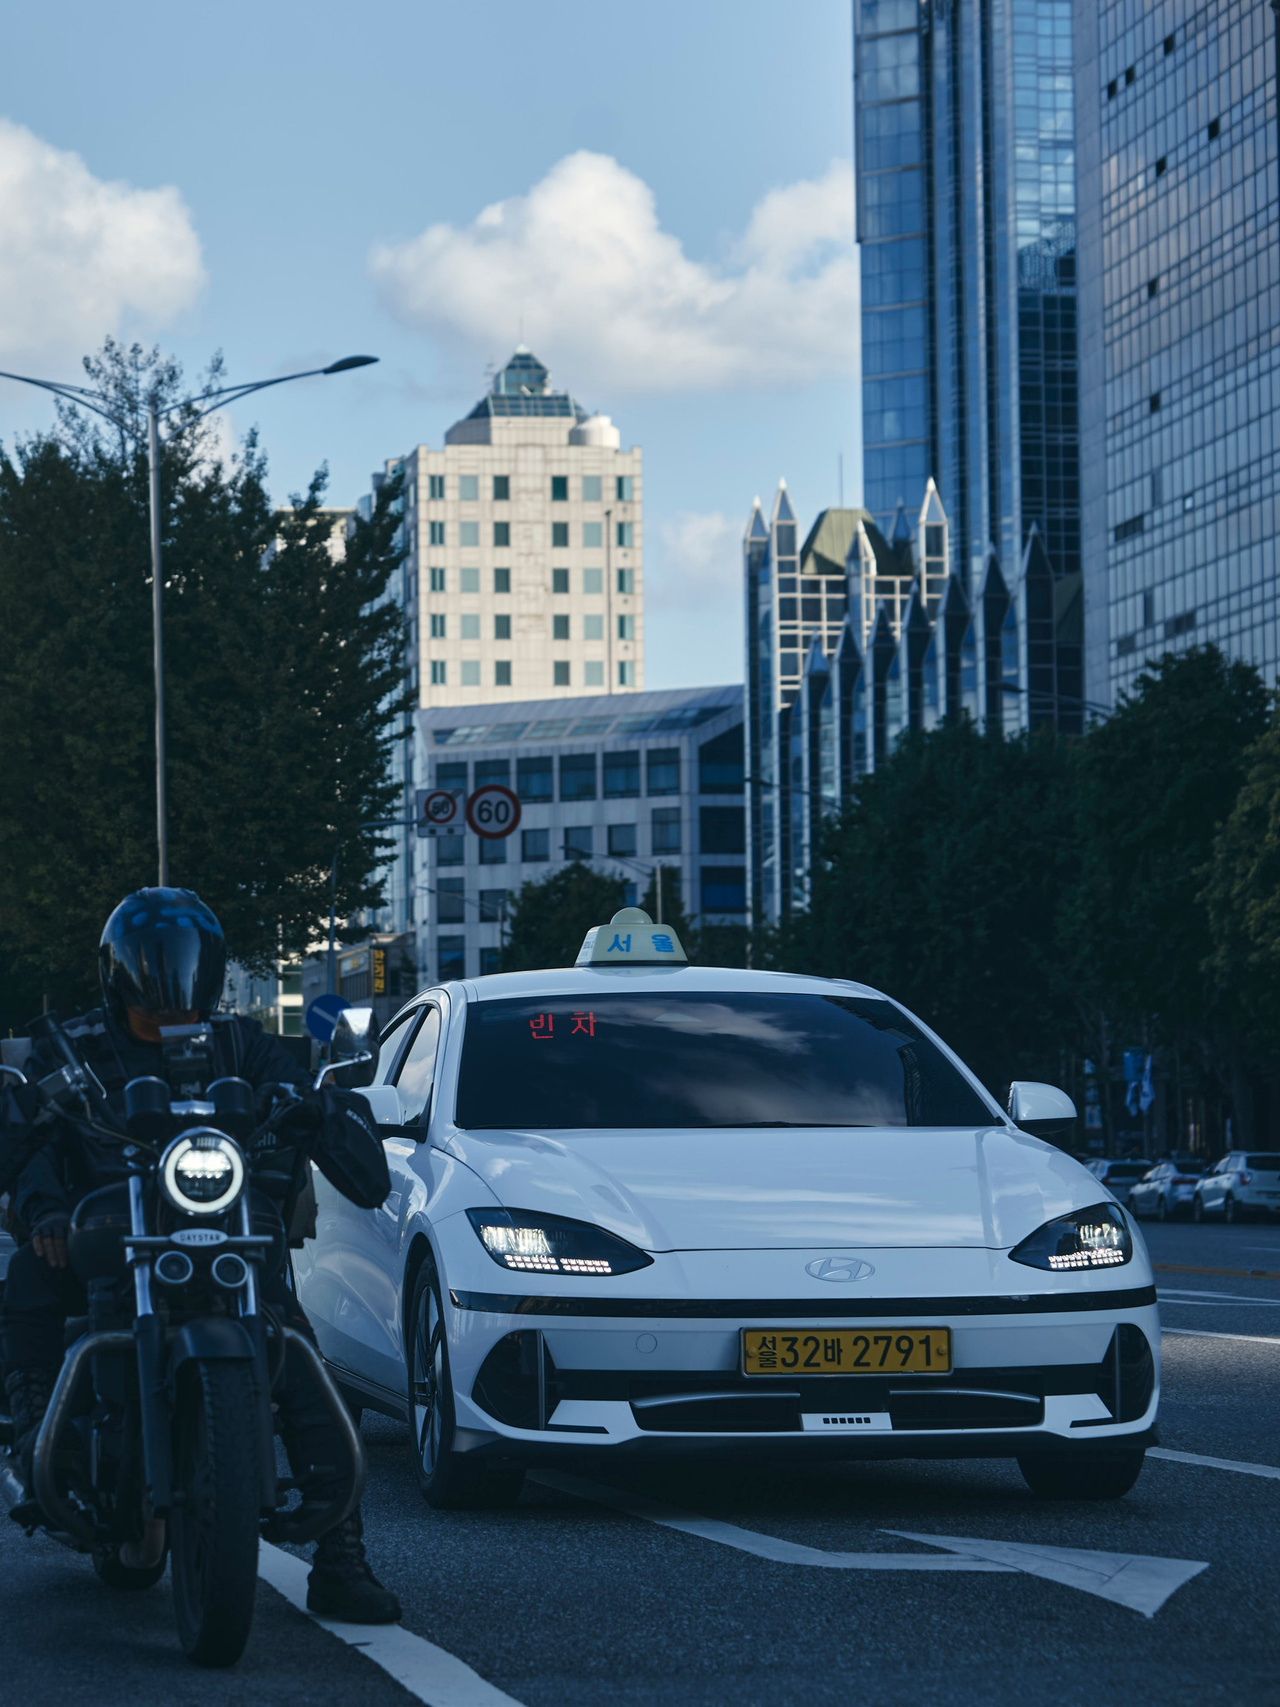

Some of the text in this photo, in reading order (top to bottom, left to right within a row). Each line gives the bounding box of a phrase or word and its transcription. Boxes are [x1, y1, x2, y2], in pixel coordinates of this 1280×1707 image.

[478, 800, 510, 823] 60
[181, 1232, 220, 1243] DAYSTAR
[852, 1334, 932, 1367] 2791
